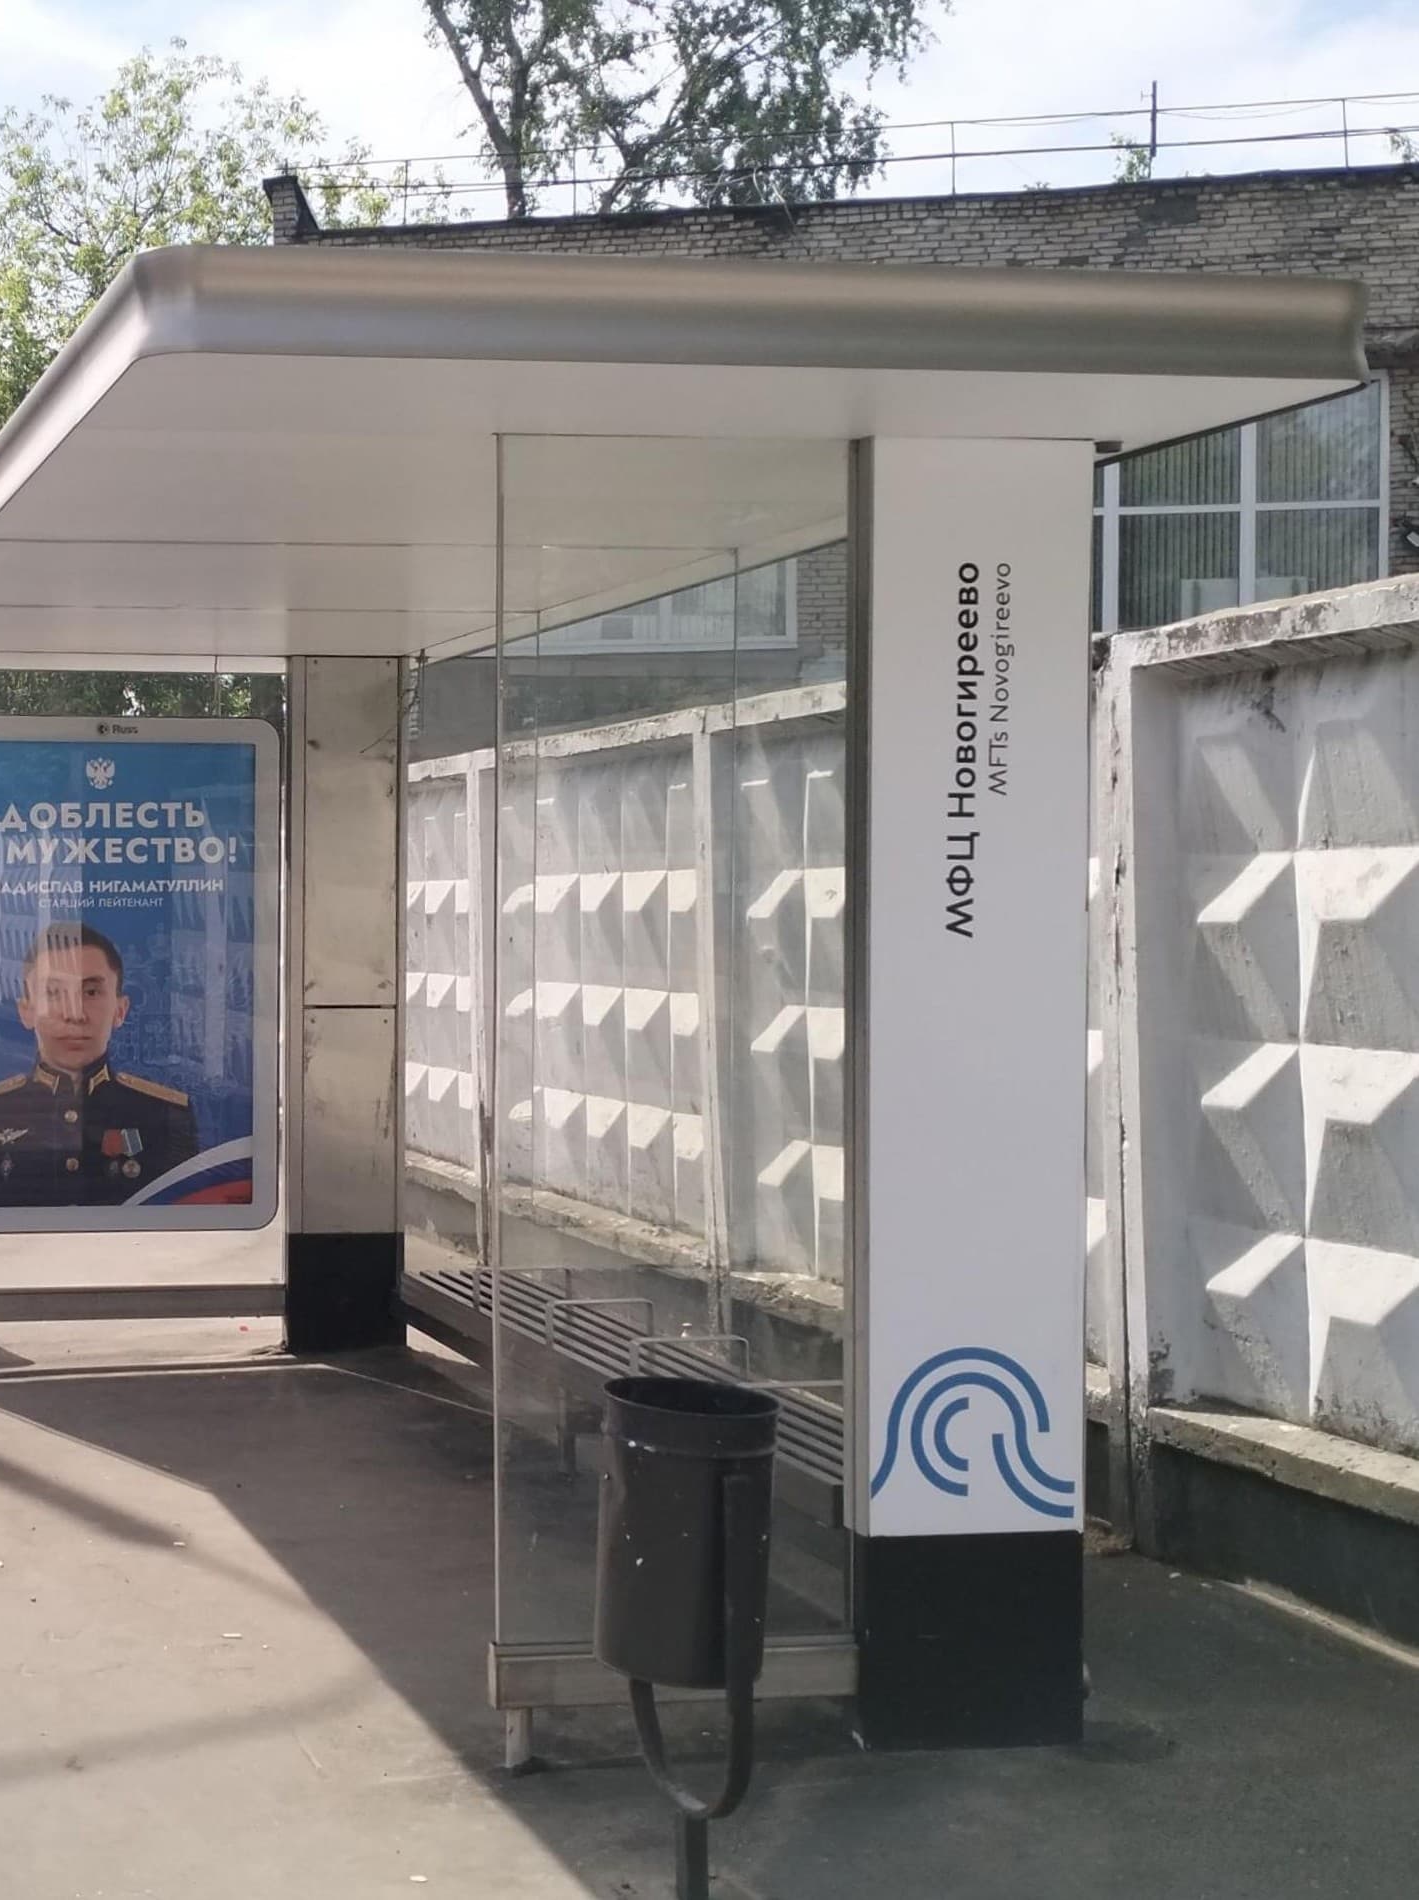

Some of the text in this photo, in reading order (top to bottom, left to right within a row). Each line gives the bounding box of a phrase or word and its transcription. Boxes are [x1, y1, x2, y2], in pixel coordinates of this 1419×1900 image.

[988, 562, 1015, 796] MFTs Novogireevo
[945, 562, 985, 938] МФЦ Новогиреево
[6, 836, 237, 865] МУЖЕСТВО!
[89, 878, 224, 893] НИГАМАТУЛЛИН
[38, 897, 164, 909] СТАРШИЙ ЛЕЙТЕНАНТ
